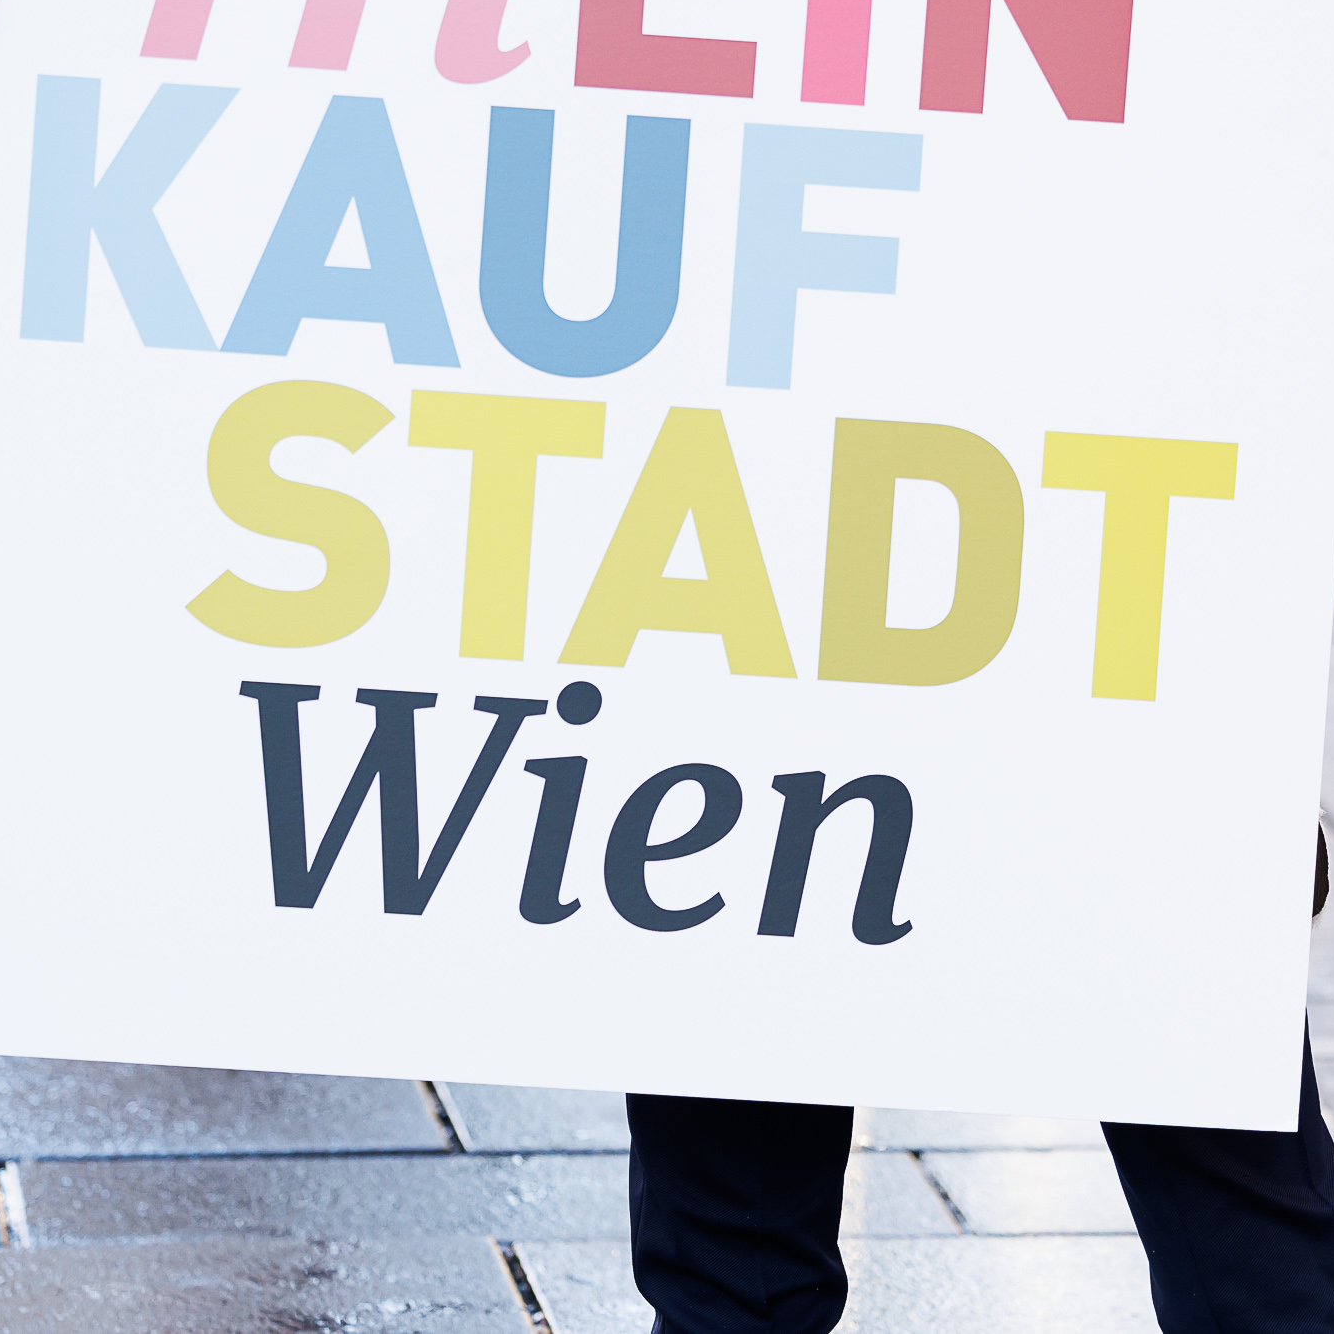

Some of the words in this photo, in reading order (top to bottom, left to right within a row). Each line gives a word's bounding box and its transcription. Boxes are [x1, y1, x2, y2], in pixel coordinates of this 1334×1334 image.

[21, 75, 923, 389] KAUF
[186, 381, 1238, 701] STADT
[239, 681, 913, 945] Wien
